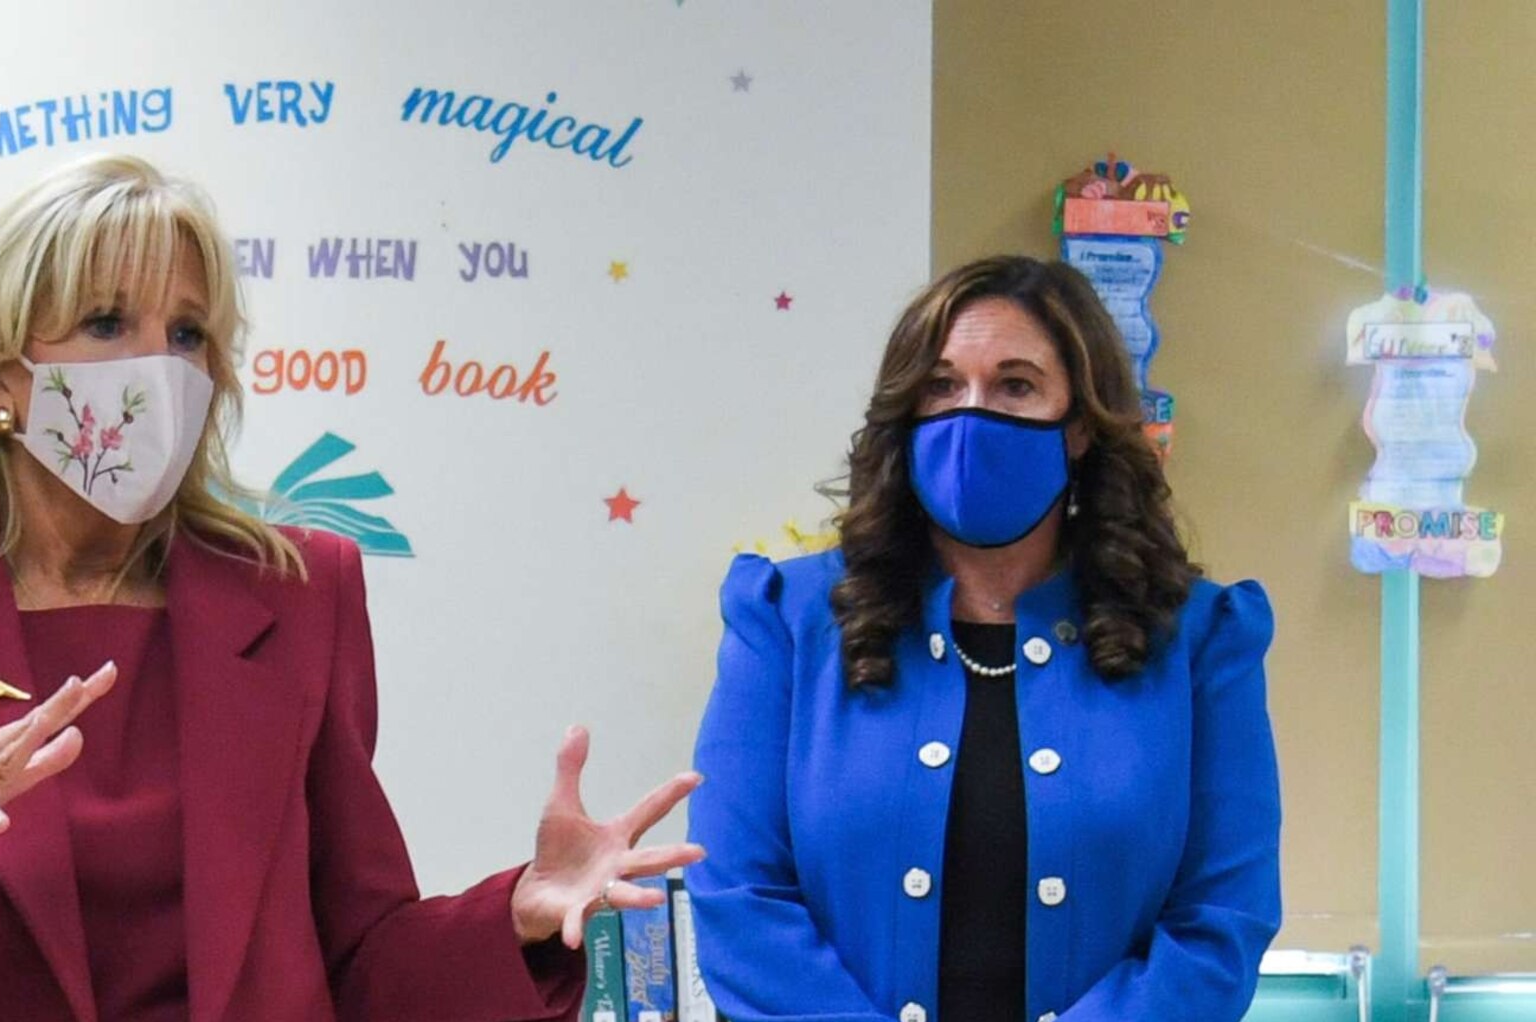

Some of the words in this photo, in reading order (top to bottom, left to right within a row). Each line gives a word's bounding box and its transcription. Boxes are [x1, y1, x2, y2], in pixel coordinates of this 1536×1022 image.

[223, 81, 335, 127] VERY
[400, 86, 645, 168] magical
[307, 238, 418, 281] WHEN
[457, 242, 529, 282] YOU
[419, 340, 558, 406] book
[1356, 510, 1499, 541] PROMISE
